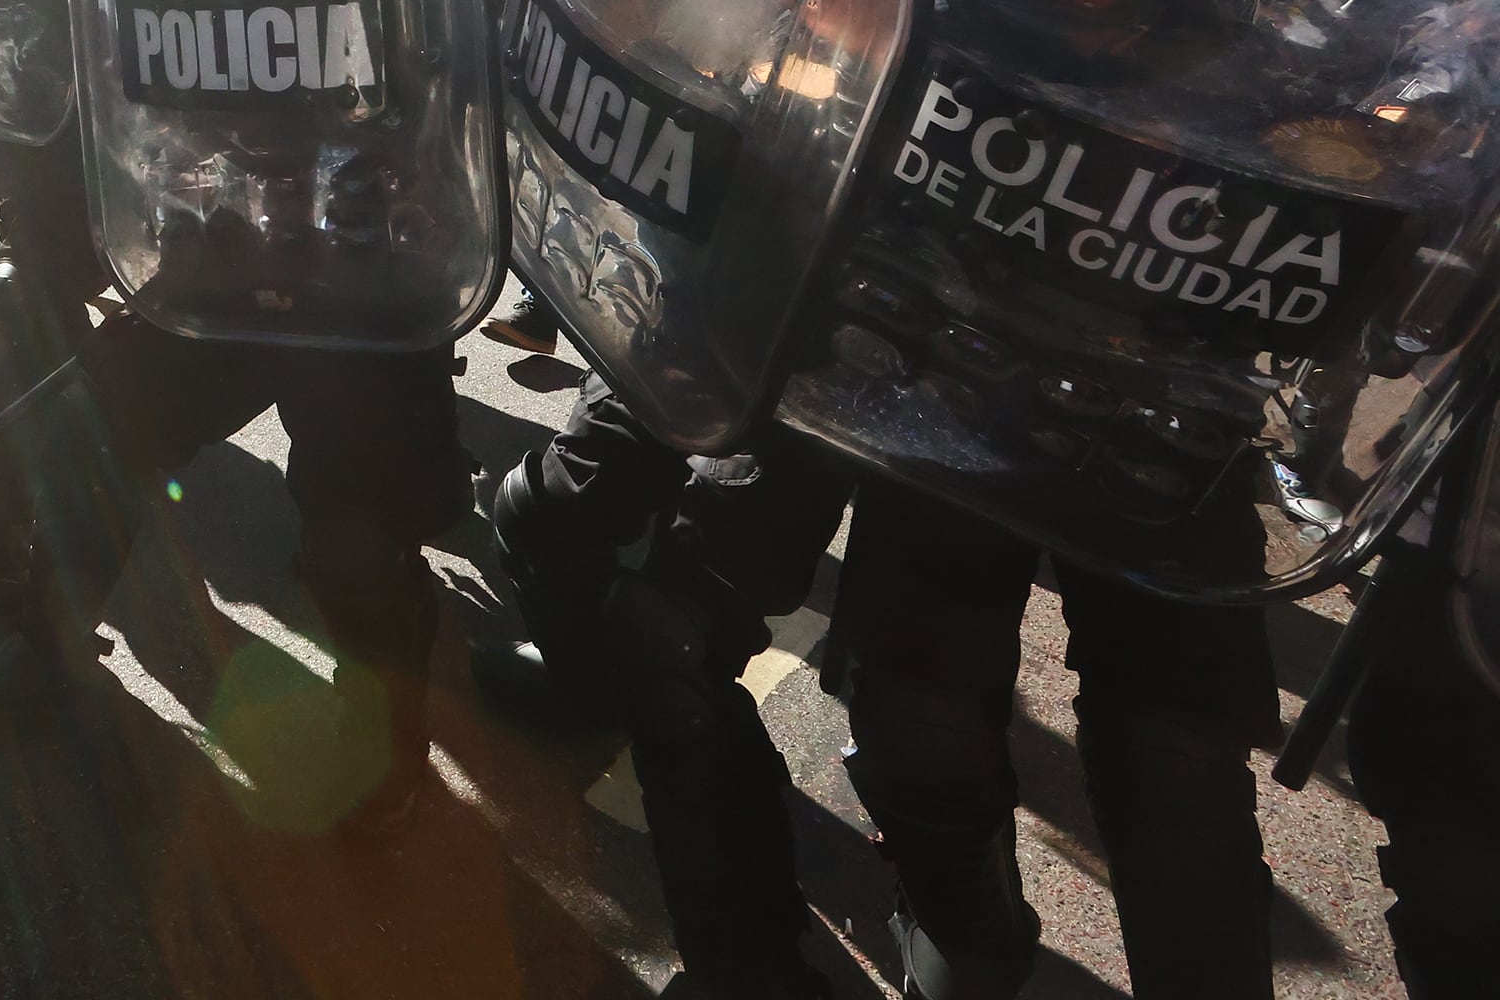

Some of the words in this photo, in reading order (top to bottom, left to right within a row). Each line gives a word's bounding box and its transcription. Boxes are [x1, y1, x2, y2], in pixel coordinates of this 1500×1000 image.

[133, 2, 376, 92] POLICIA
[893, 140, 967, 208] DE
[973, 185, 1047, 252] LA
[1067, 228, 1329, 325] CIUDAD
[910, 79, 1343, 286] POLICIA
